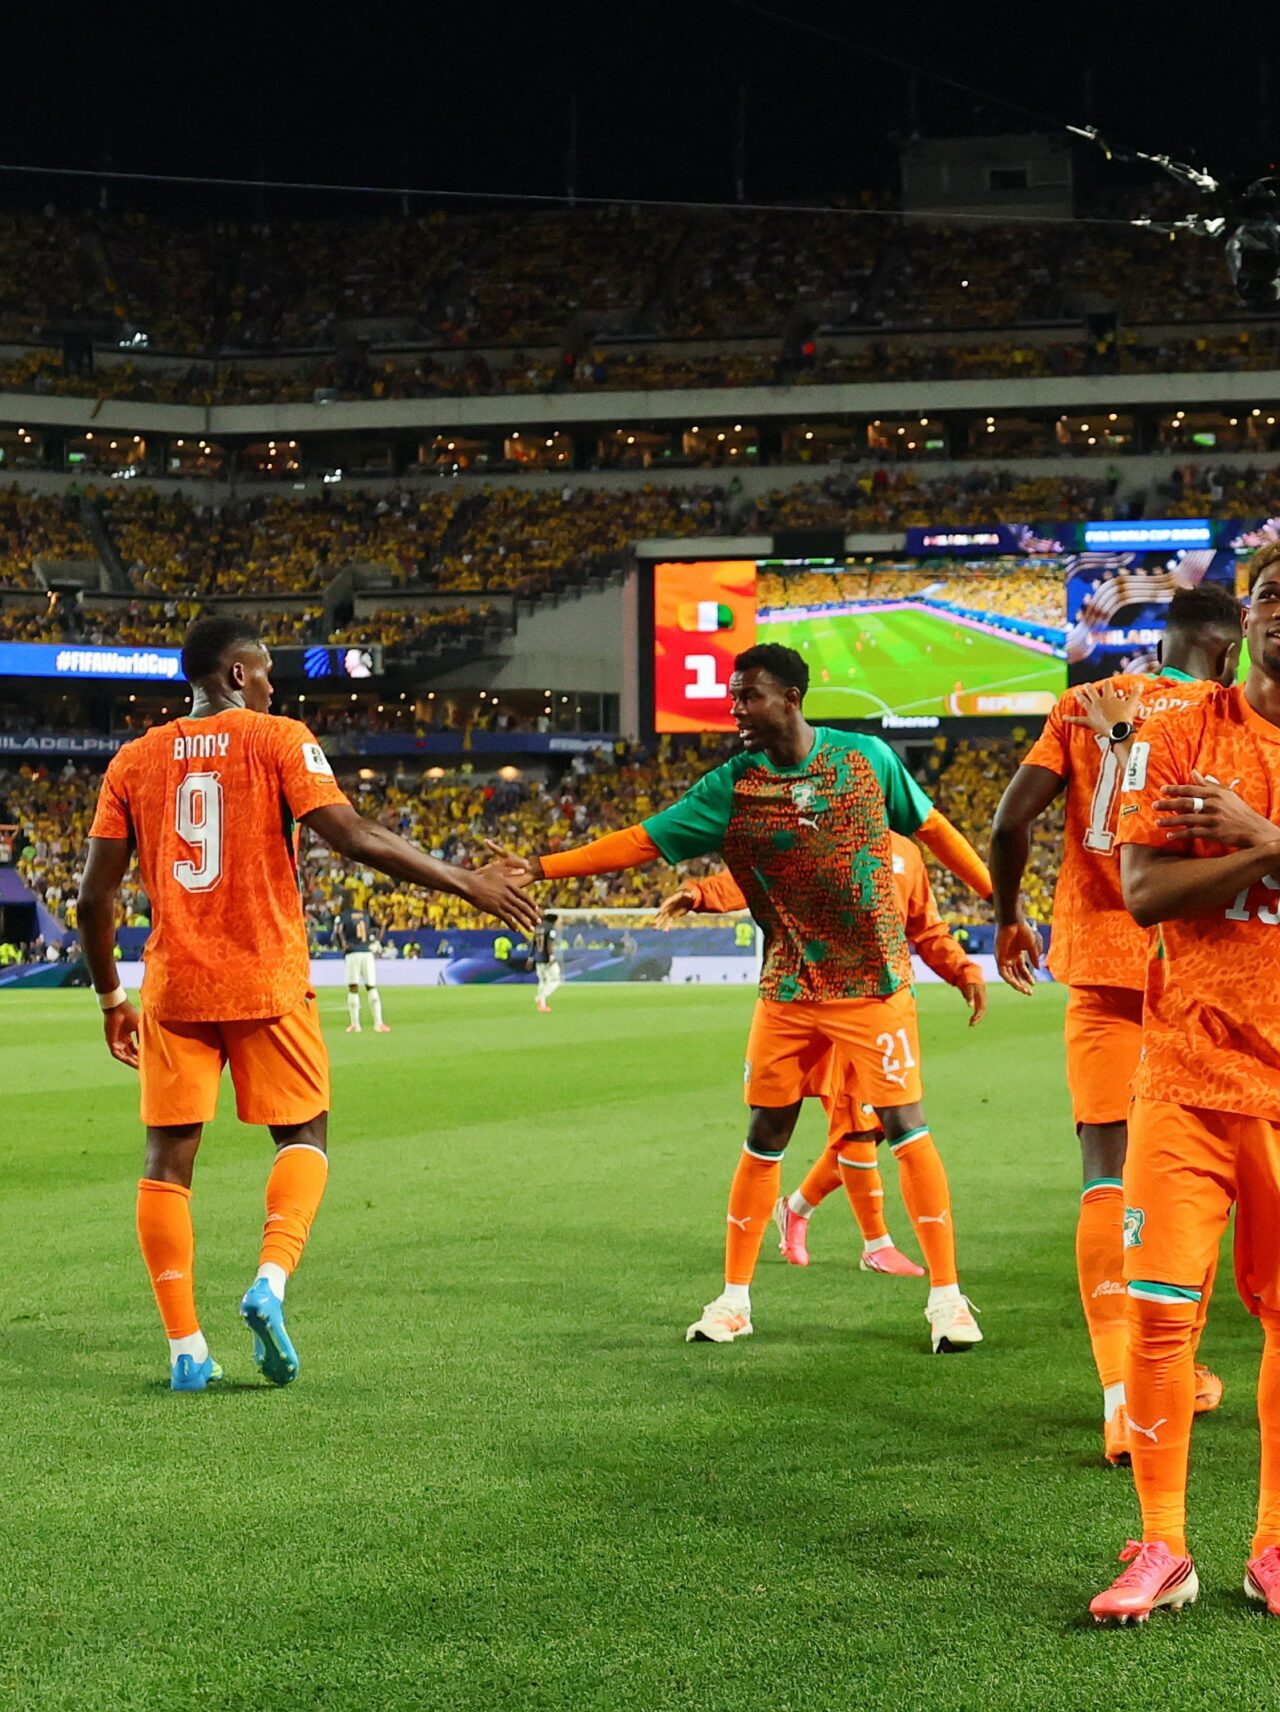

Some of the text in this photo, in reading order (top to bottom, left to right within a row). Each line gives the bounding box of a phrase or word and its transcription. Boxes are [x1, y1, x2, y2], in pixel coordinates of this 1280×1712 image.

[56, 650, 179, 678] #FIFAWorldCup
[684, 654, 728, 699] 1
[172, 770, 225, 893] 9
[876, 1027, 917, 1073] 21
